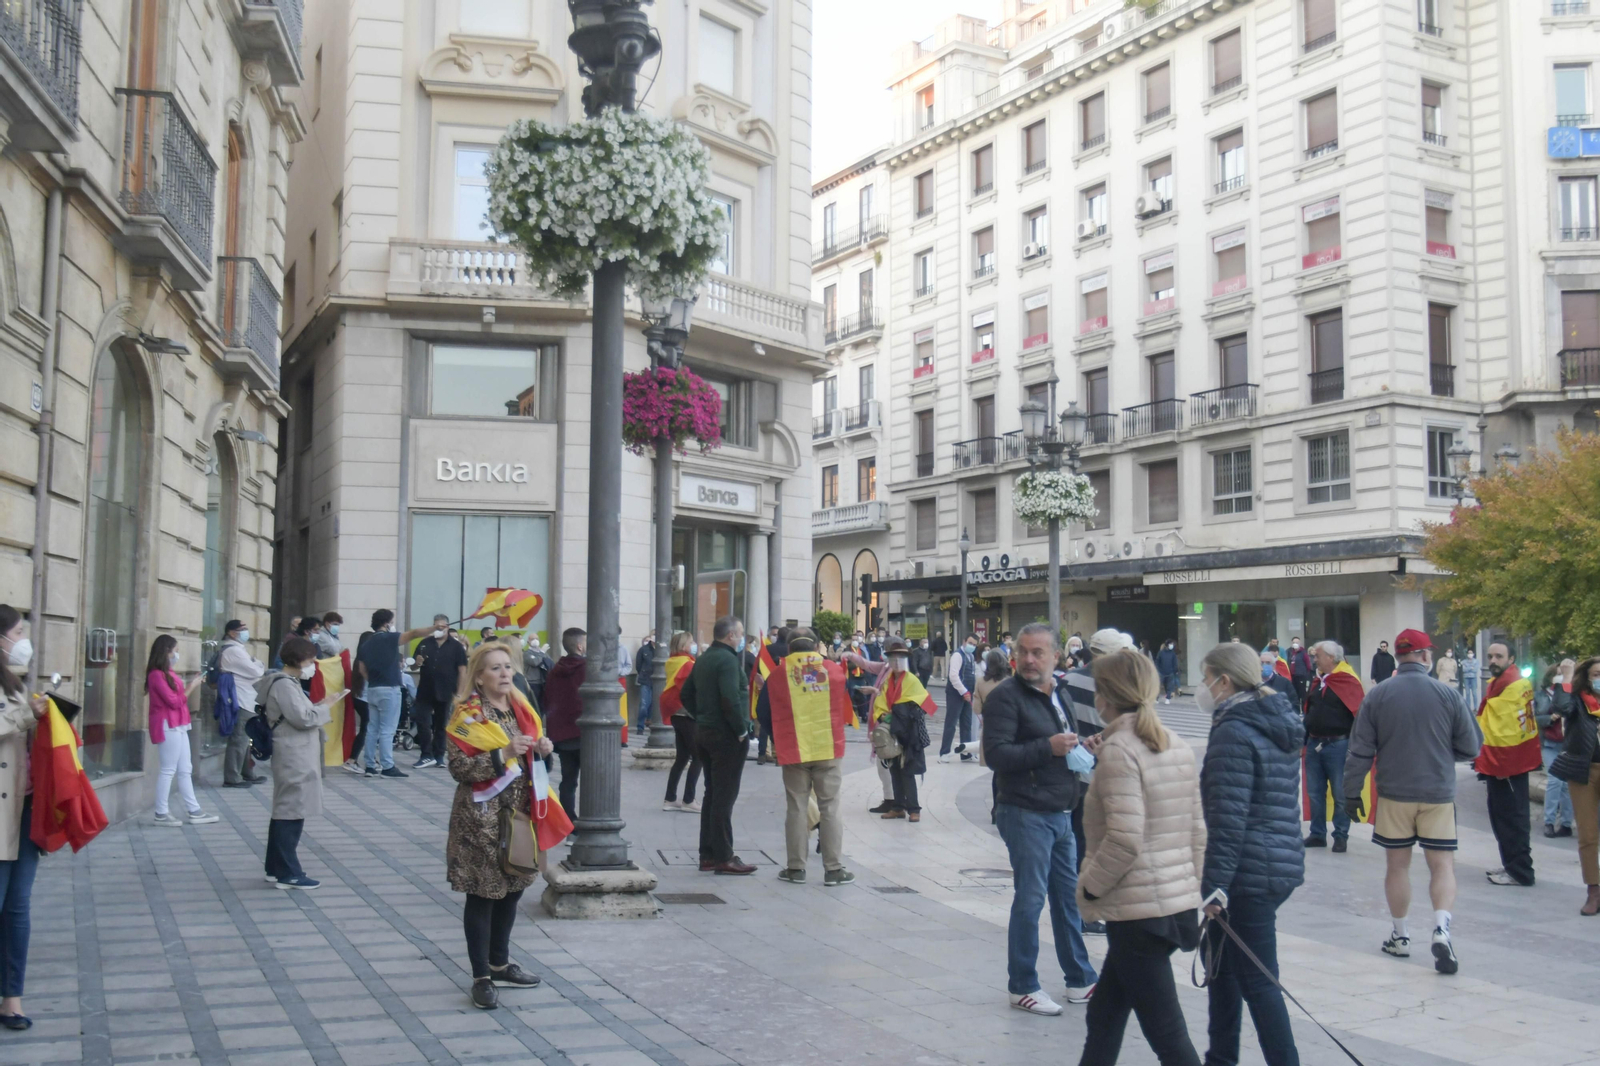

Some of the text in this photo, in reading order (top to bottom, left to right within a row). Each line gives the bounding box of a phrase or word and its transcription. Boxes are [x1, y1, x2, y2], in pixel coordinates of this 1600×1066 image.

[437, 457, 528, 483] Bankia
[698, 485, 738, 506] Bankia
[1286, 562, 1342, 576] ROSSELLI
[1163, 570, 1211, 583] ROSSELLI
[973, 596, 991, 608] OUTLET
